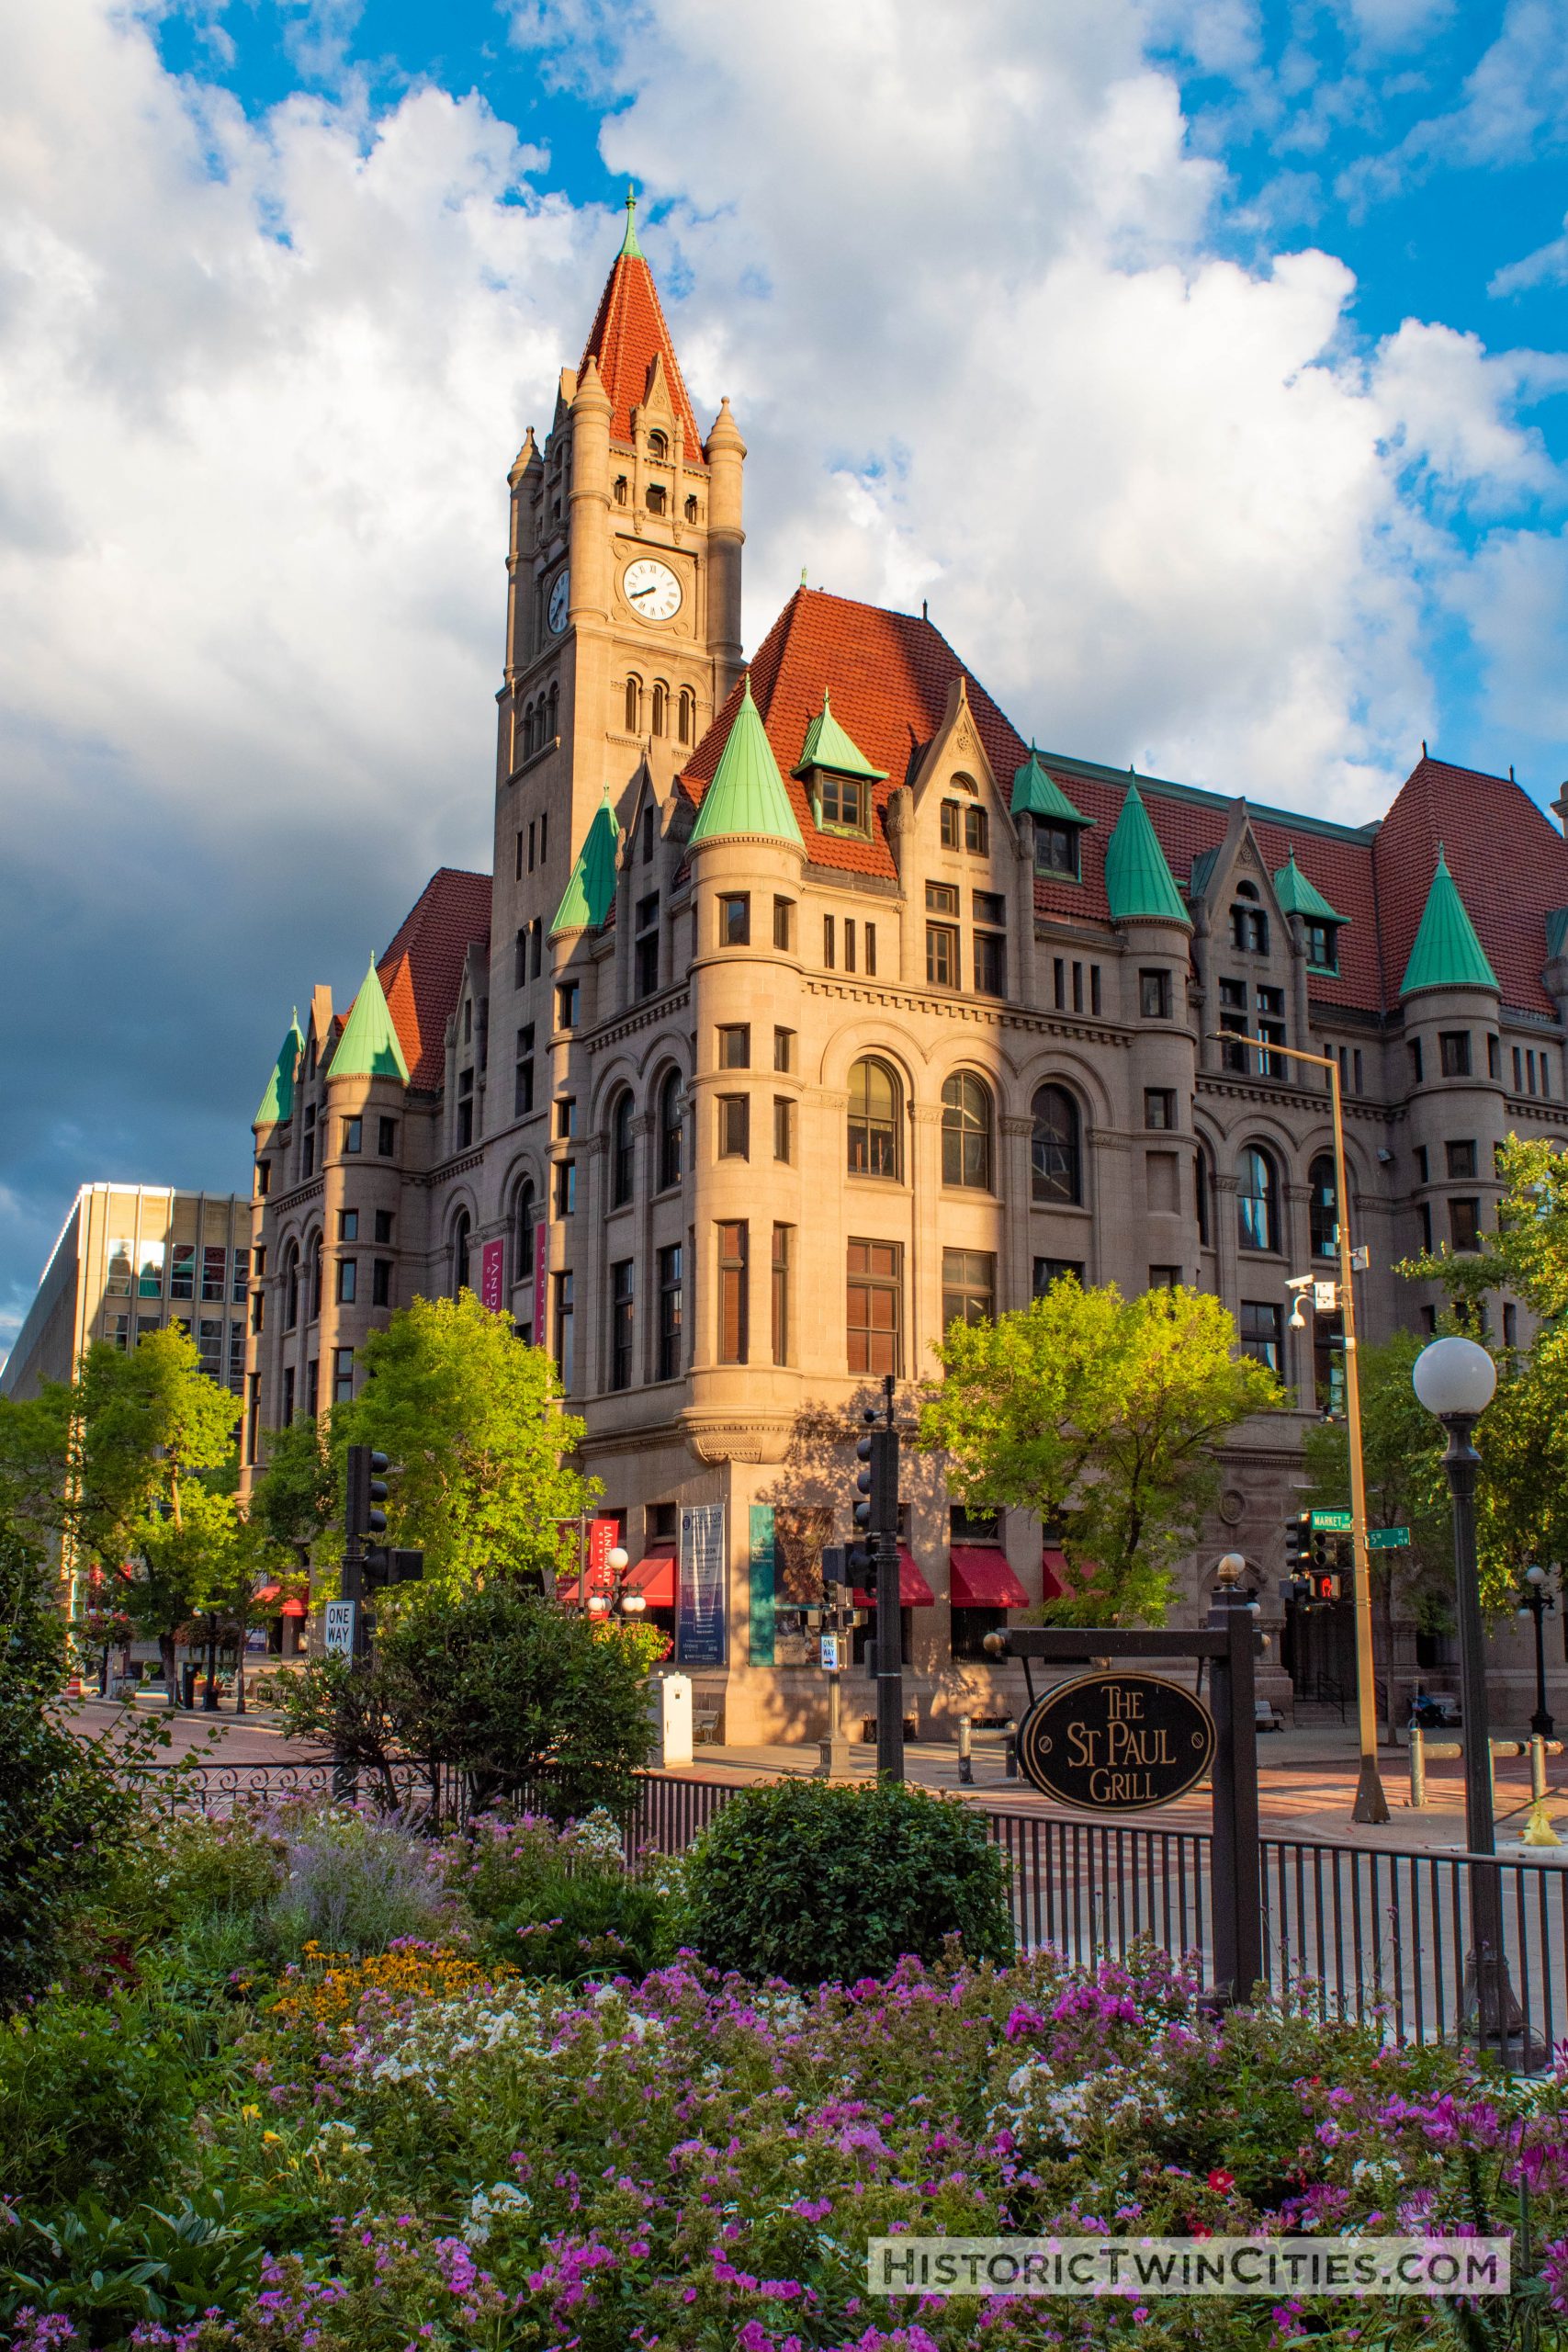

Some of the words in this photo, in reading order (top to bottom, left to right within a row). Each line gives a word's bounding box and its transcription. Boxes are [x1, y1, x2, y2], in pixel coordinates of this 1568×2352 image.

[1314, 1515, 1342, 1527] MARKET
[329, 1608, 349, 1623] ONE
[328, 1626, 349, 1643] WAY
[823, 1639, 834, 1647] ONE
[823, 1648, 834, 1657] WAY
[1100, 1685, 1145, 1720] THE
[1067, 1722, 1101, 1767] ST
[1107, 1721, 1177, 1767] PAUL
[1089, 1769, 1157, 1803] GRILL
